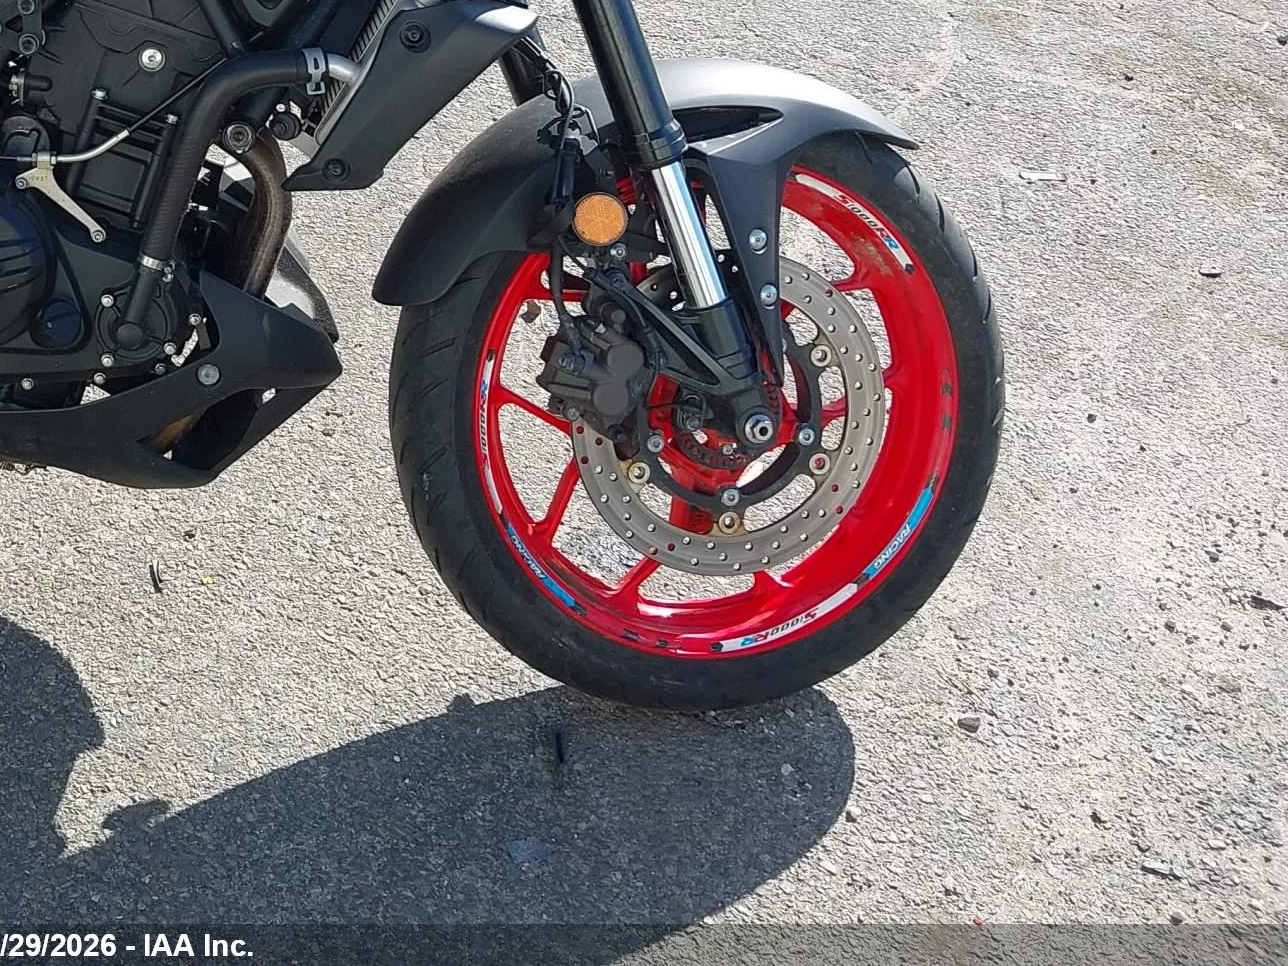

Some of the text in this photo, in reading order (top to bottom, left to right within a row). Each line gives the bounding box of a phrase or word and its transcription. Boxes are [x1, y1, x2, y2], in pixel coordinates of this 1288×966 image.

[833, 194, 899, 250] S1000RR
[511, 535, 547, 580] RACING
[874, 522, 912, 569] RACING
[740, 607, 819, 647] S1000RR
